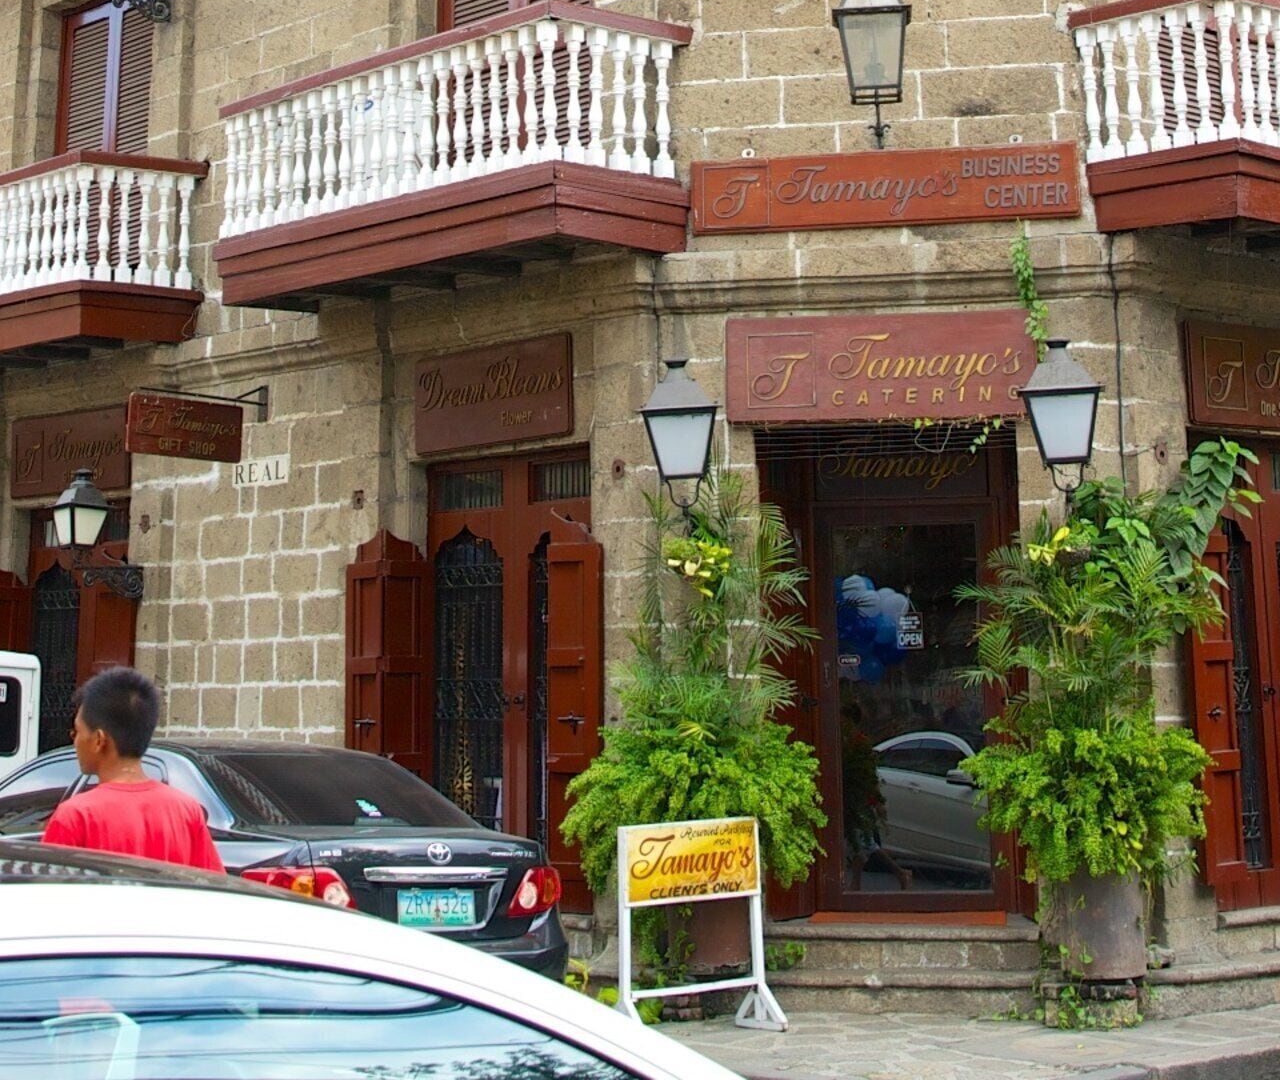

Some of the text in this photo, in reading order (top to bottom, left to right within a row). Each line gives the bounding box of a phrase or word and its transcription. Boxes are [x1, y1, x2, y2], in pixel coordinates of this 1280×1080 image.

[961, 153, 1061, 178] BUSINESS
[775, 165, 958, 217] Tamayo's
[984, 182, 1069, 208] CENTER
[828, 332, 1023, 392] Tamayo's
[420, 356, 564, 412] Dream Blooms
[831, 386, 1021, 406] CATERING
[1260, 400, 1277, 416] One
[189, 440, 216, 456] SHOP
[235, 460, 285, 484] REAL
[900, 633, 921, 646] OPEN
[631, 834, 753, 882] Tamayo's
[650, 881, 743, 899] CLIENTS ONLY
[405, 895, 469, 915] ZRY 326
